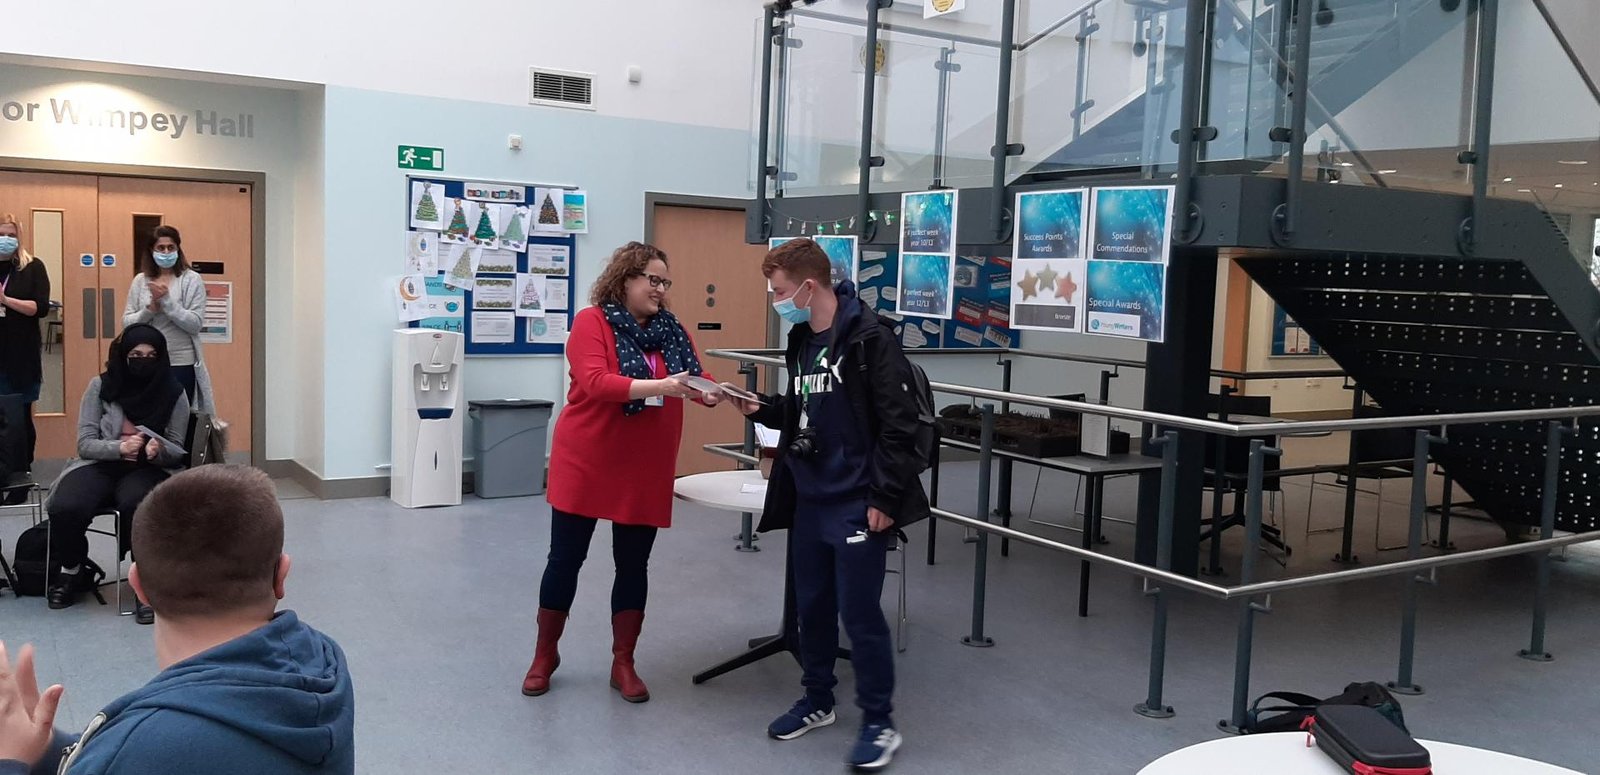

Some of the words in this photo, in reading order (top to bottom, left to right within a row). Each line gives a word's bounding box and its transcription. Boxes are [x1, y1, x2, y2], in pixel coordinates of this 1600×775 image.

[195, 109, 255, 138] Hall
[1023, 233, 1045, 241] Success
[1045, 232, 1063, 241] Points
[1111, 231, 1134, 241] Special
[1031, 244, 1053, 253] Awards
[1096, 243, 1148, 253] Commendations
[1088, 297, 1114, 308] Special
[1115, 299, 1141, 310] Awards
